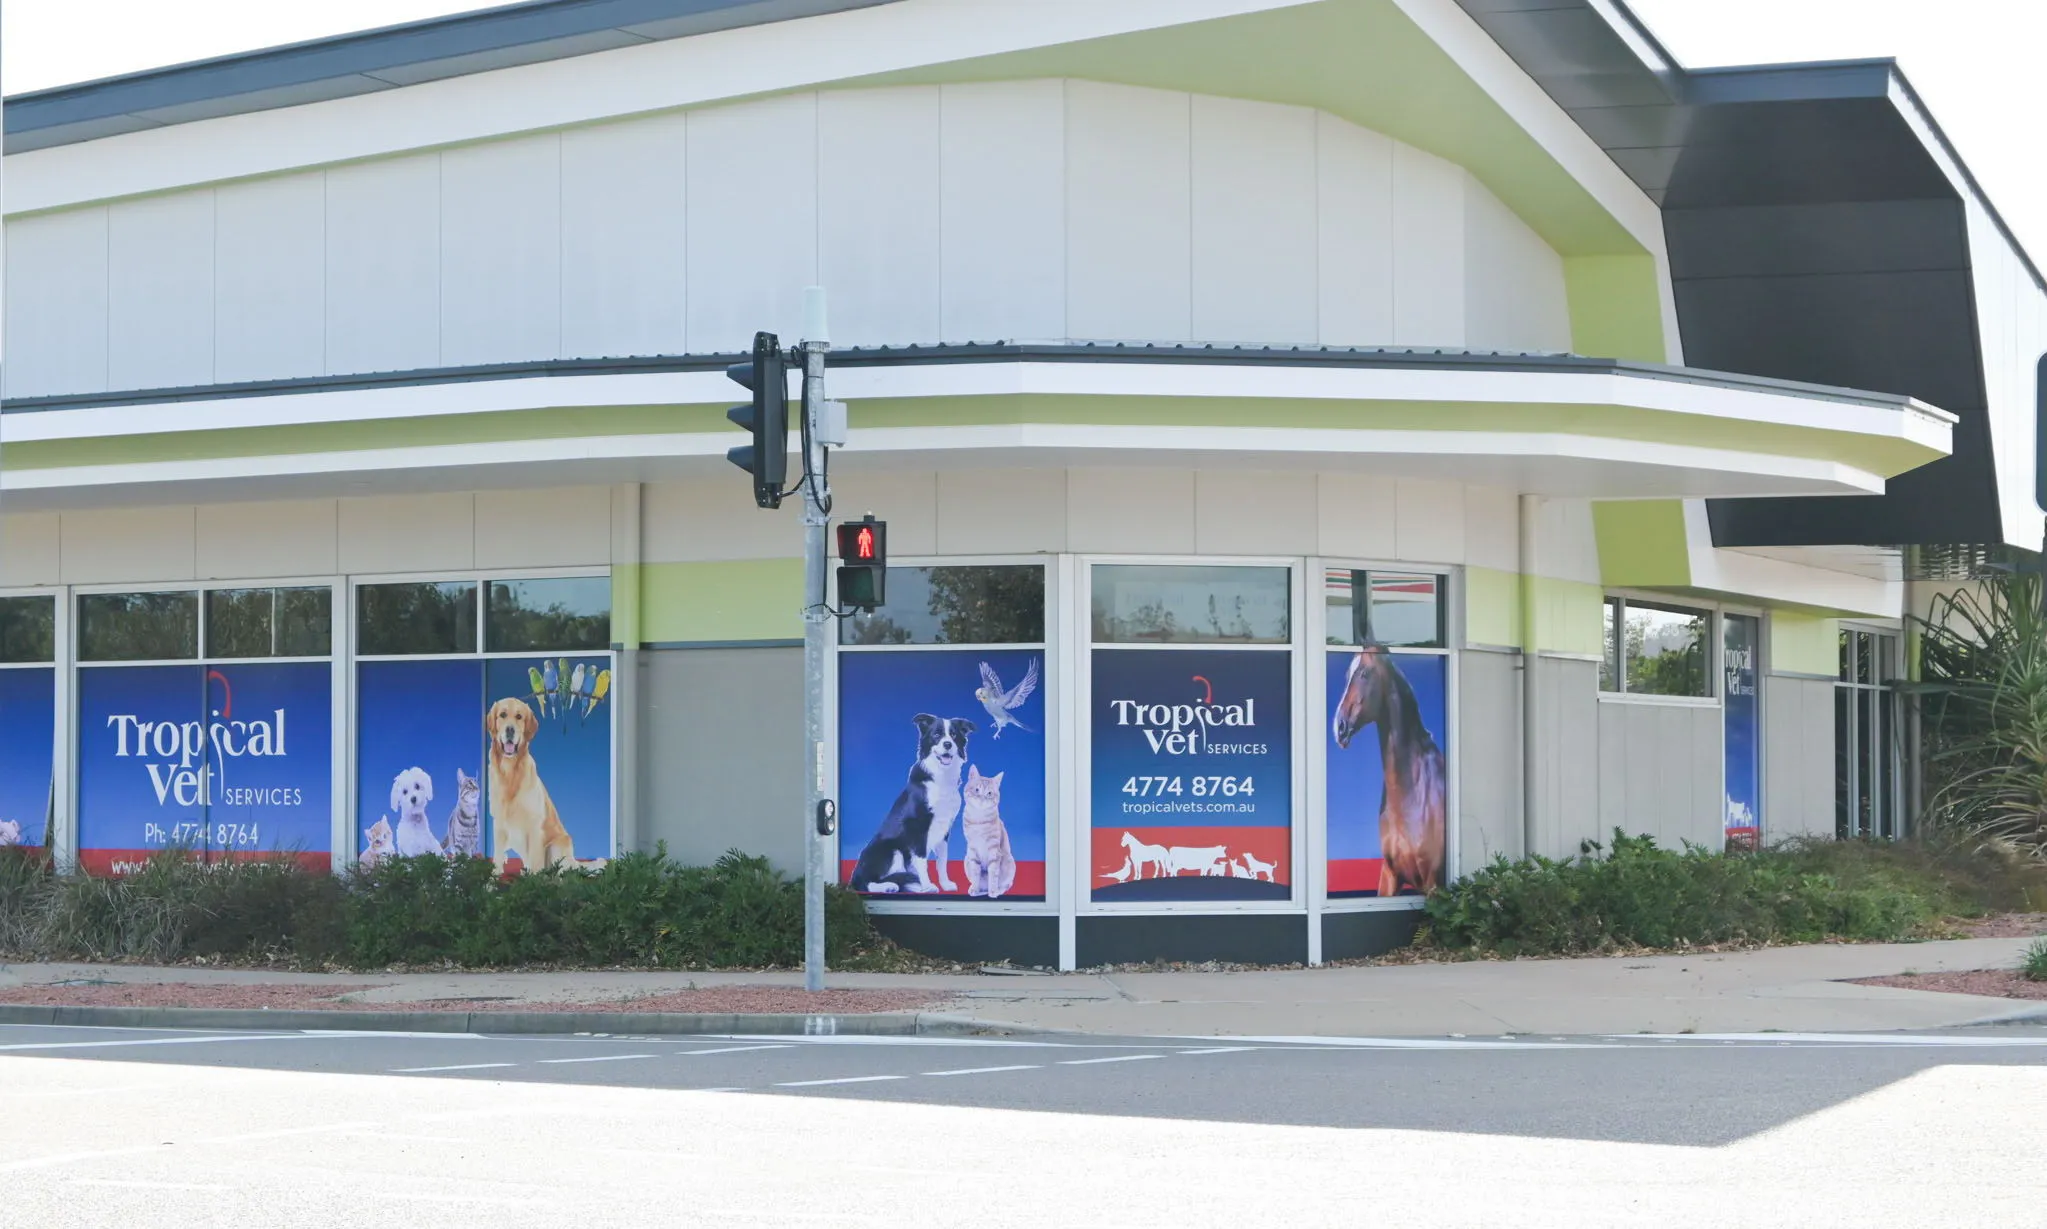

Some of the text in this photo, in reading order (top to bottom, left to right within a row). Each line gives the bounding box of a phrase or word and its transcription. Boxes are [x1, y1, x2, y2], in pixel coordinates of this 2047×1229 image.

[1725, 644, 1752, 676] ropical
[1110, 698, 1256, 732] Tropical
[106, 708, 287, 768] Tropical
[1143, 728, 1268, 755] Vet SERVICES
[225, 787, 302, 806] SERVICES
[1121, 776, 1255, 797] 4774 8764
[1122, 801, 1256, 815] tropicalvets.com.au
[144, 822, 167, 844] Ph:
[216, 821, 258, 845] 8764
